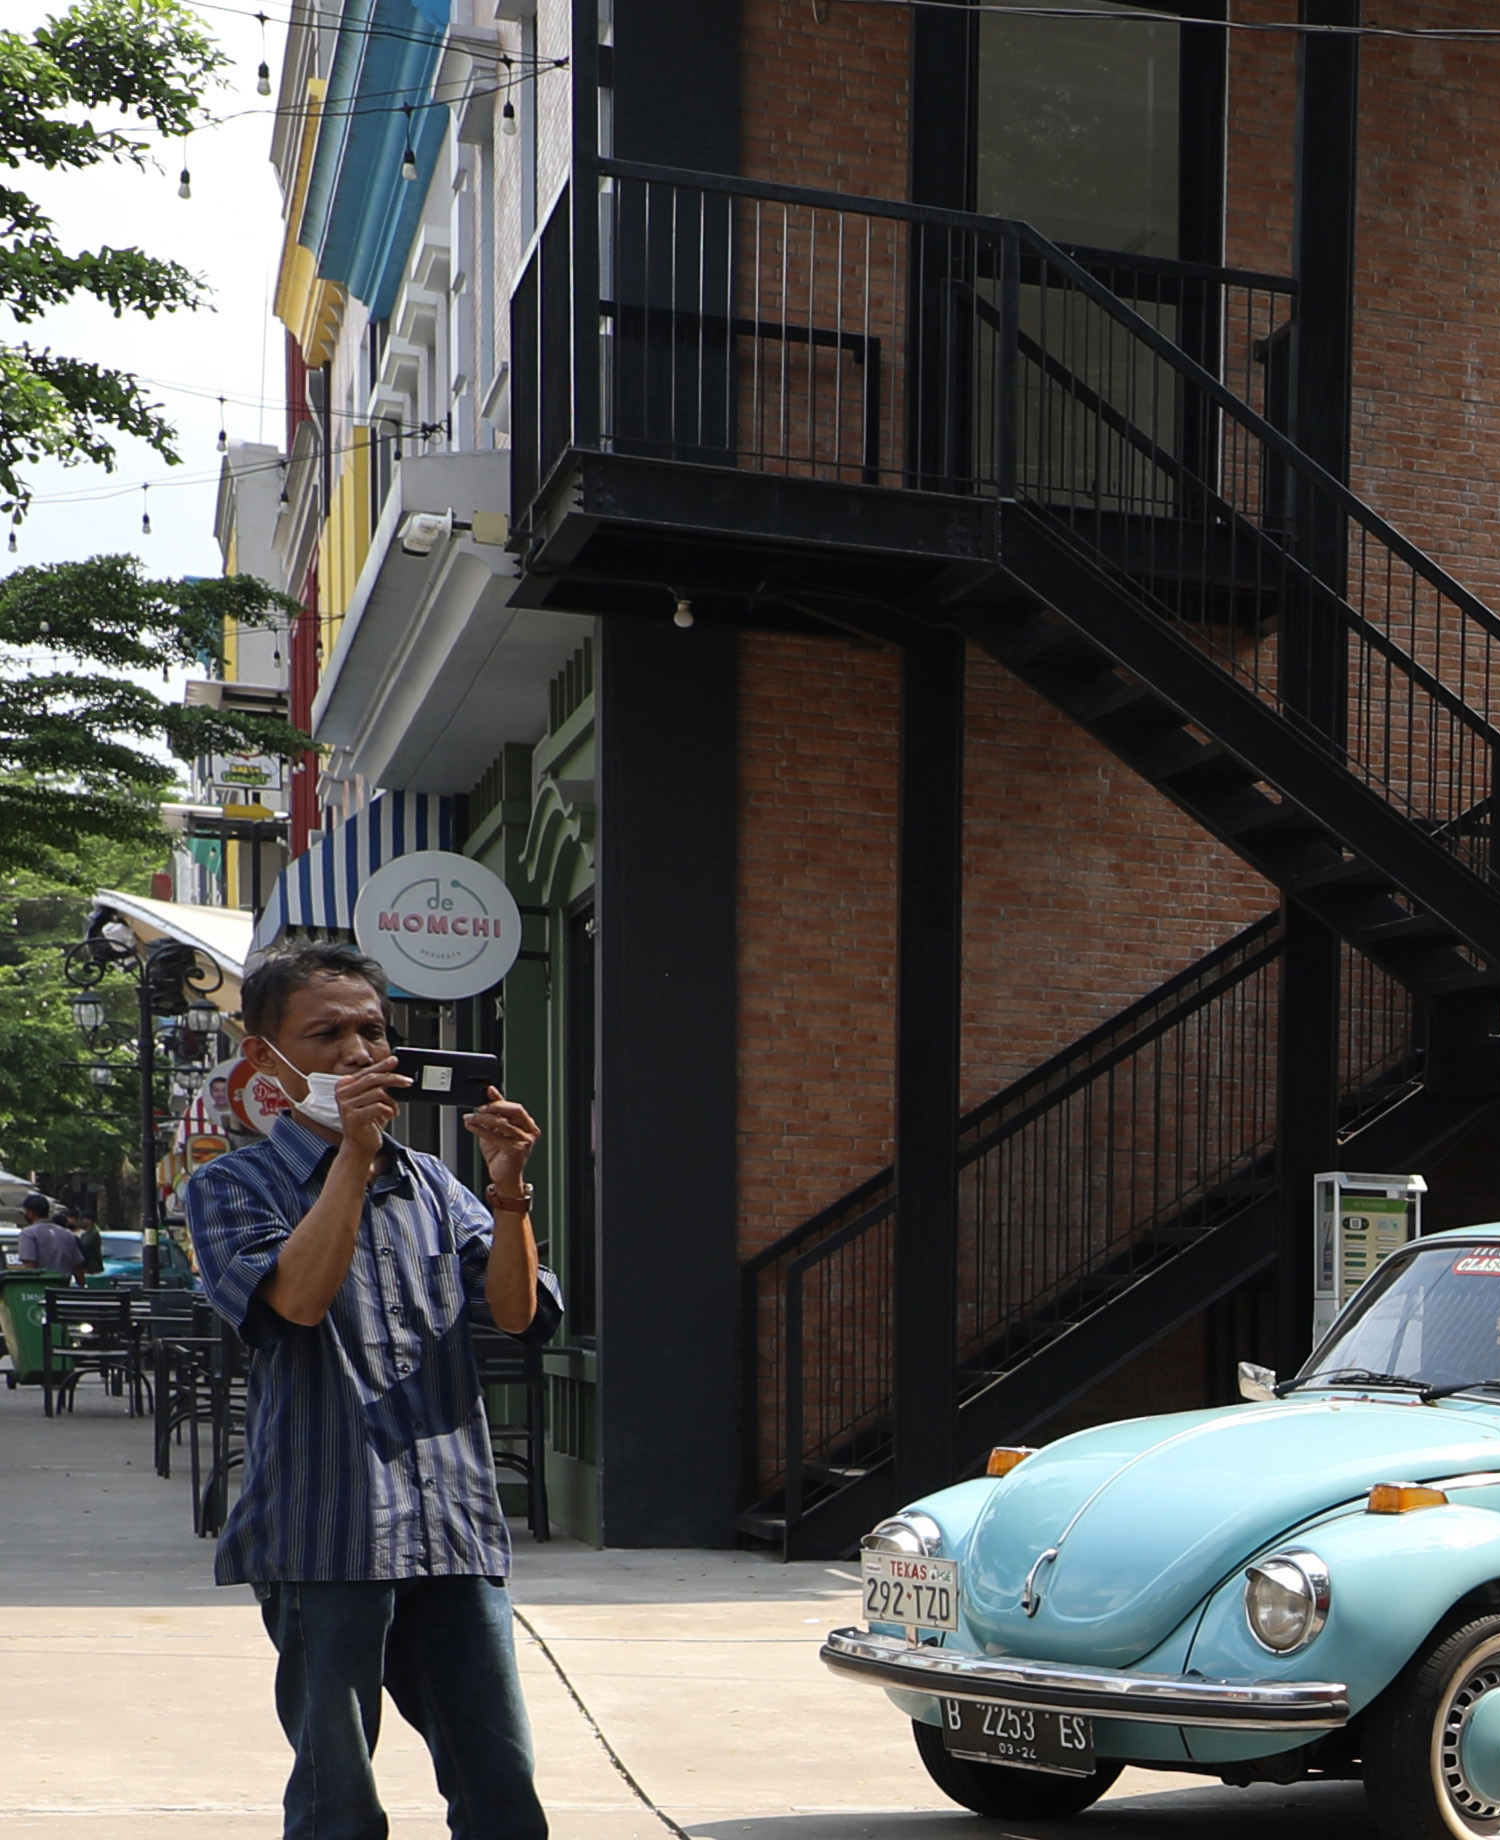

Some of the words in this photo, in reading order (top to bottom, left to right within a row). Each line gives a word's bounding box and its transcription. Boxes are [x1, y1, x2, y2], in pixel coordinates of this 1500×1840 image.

[378, 911, 501, 938] MOMCHI
[890, 1561, 927, 1580] TEXAS
[980, 1704, 1036, 1741] 2253
[1059, 1714, 1087, 1750] ES
